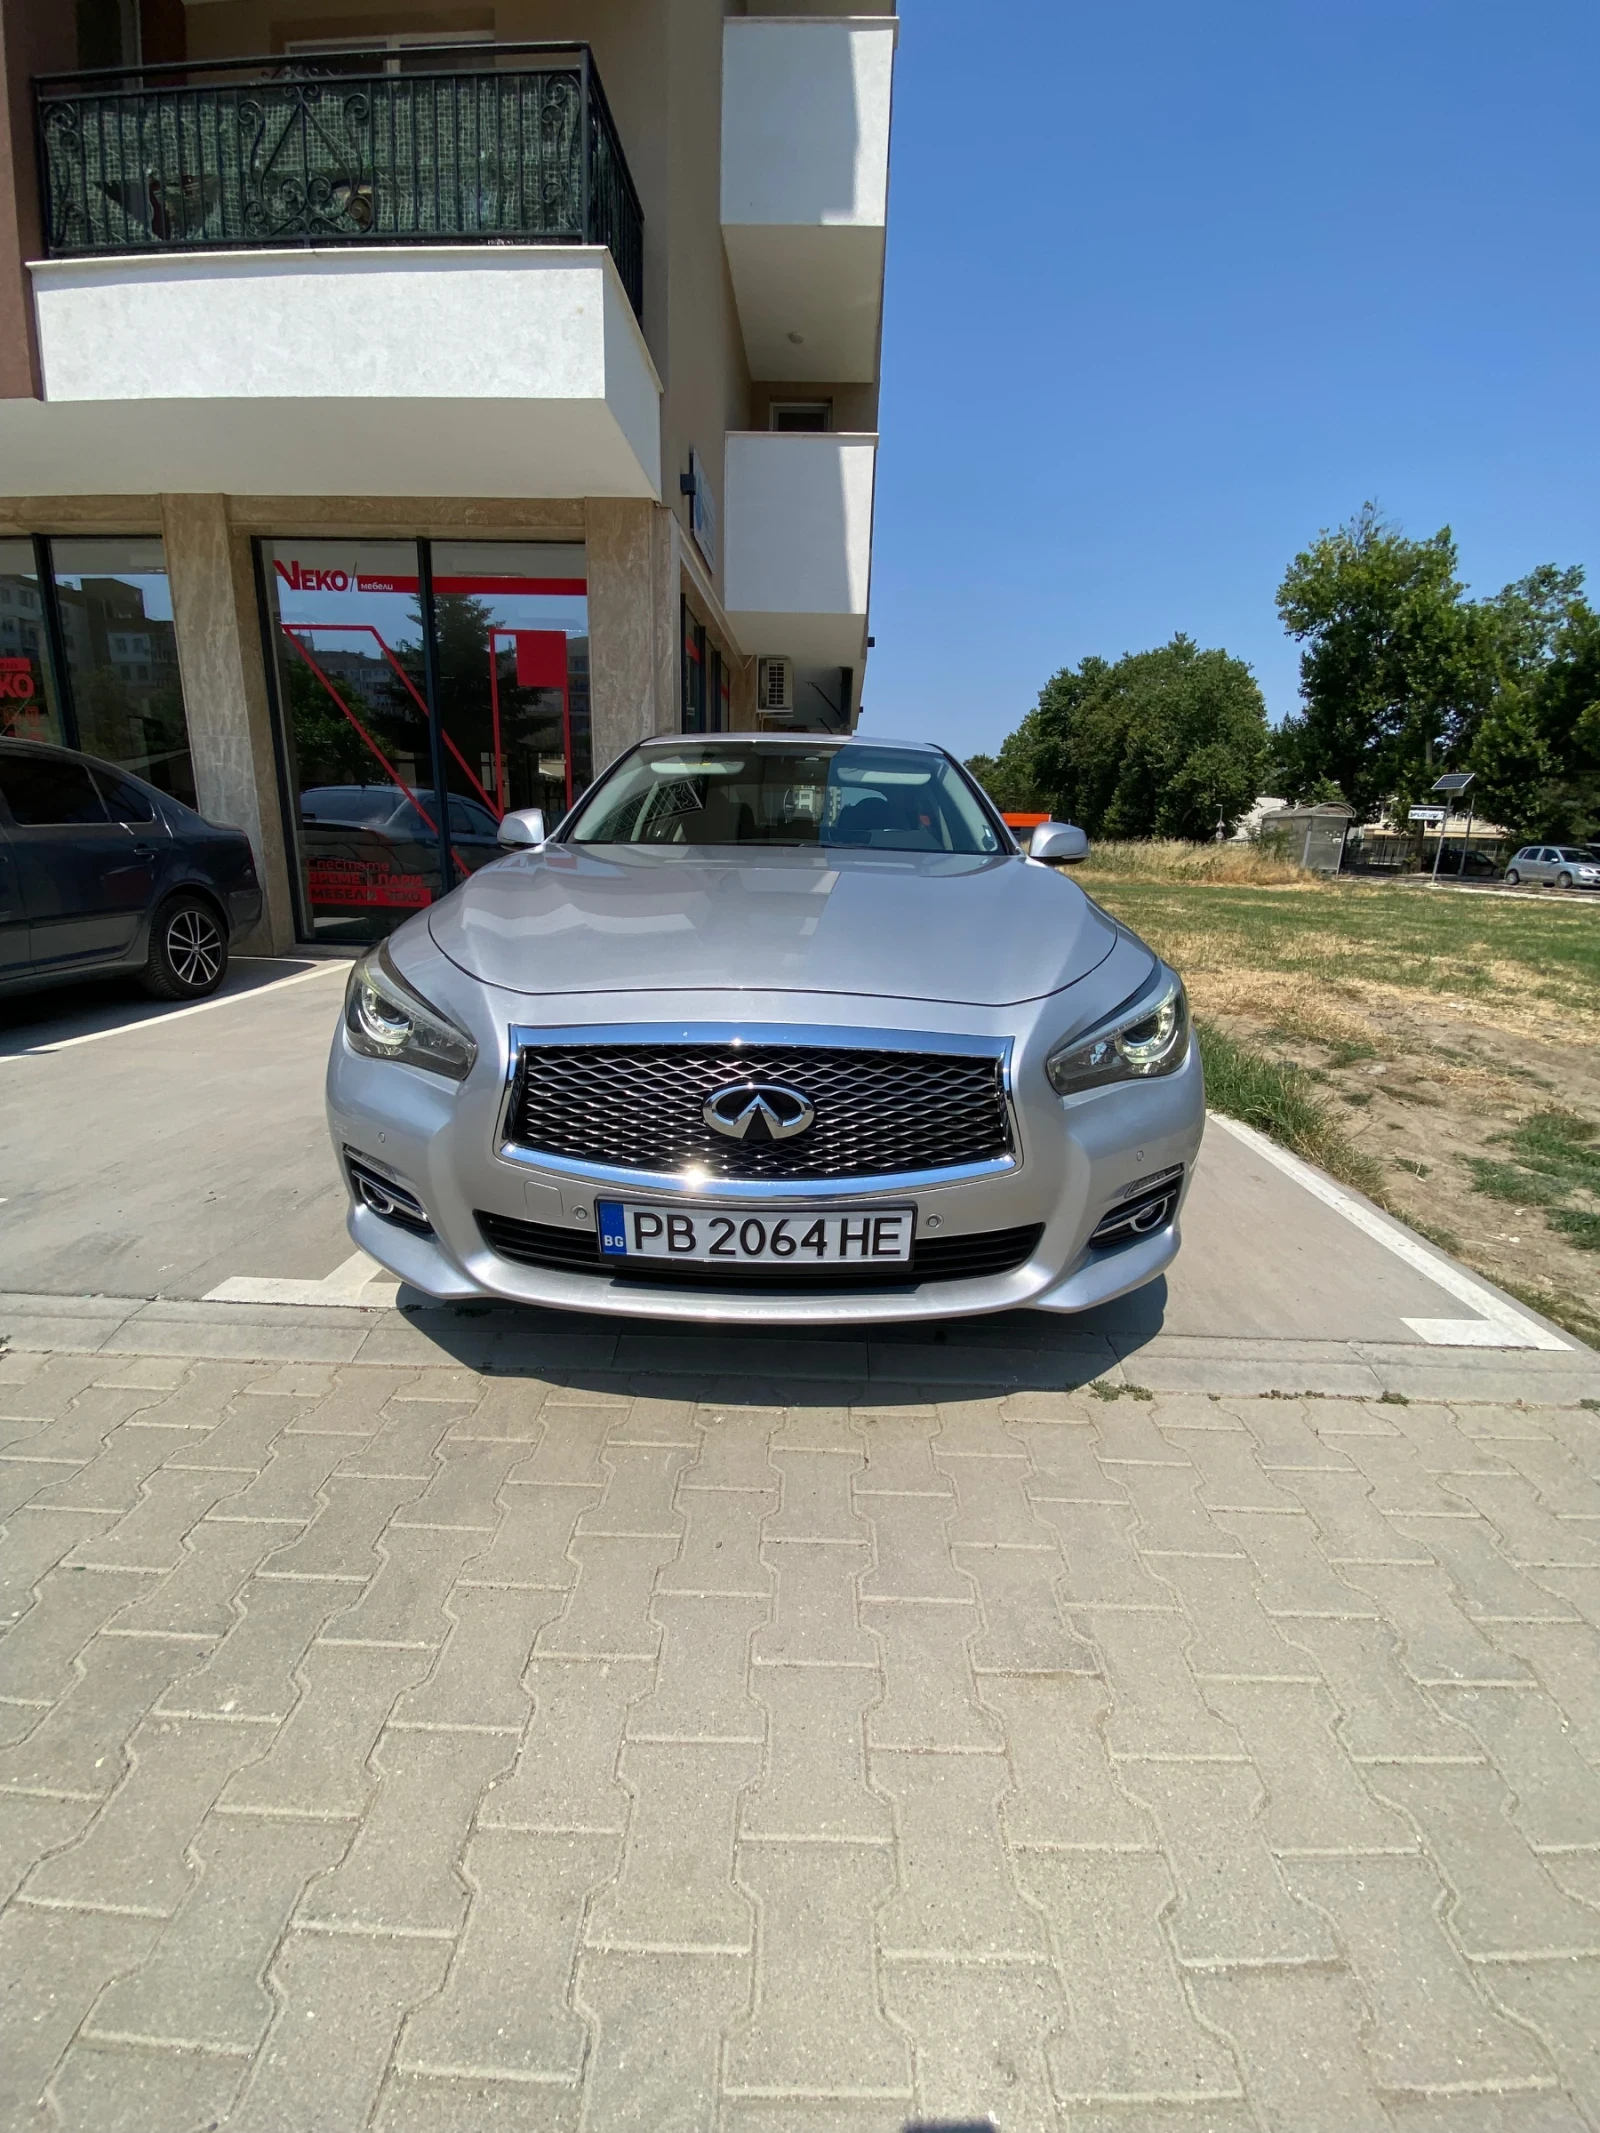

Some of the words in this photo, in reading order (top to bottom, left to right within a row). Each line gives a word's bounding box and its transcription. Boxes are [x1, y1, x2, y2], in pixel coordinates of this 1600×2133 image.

[272, 559, 349, 592] VEKO
[603, 1234, 625, 1248] BG
[633, 1211, 698, 1252] PB
[708, 1217, 828, 1257] 2064
[839, 1217, 904, 1257] HE
